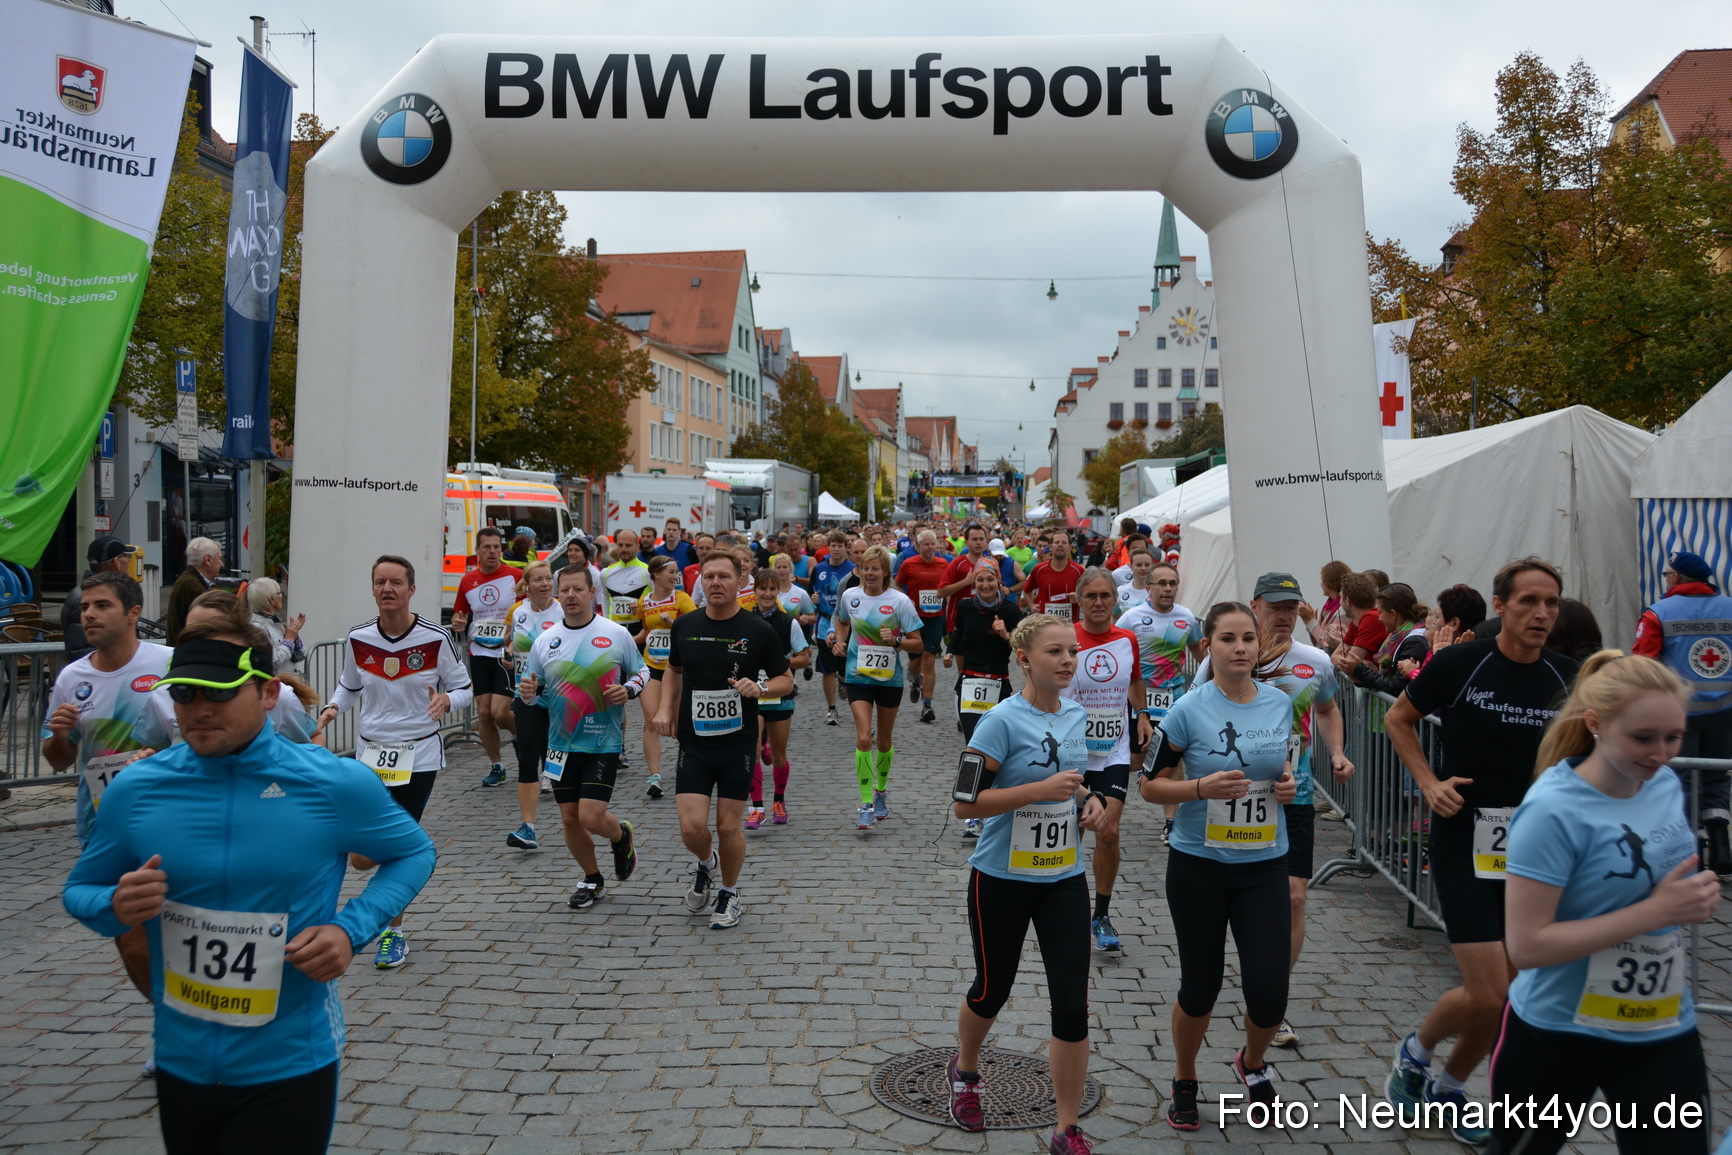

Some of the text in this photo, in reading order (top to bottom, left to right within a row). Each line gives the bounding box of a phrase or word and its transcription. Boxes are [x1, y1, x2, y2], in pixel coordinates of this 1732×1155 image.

[484, 52, 1174, 136] BMW Laufsport
[373, 95, 445, 125] BMW
[1213, 90, 1288, 120] BMW
[180, 360, 191, 386] P
[232, 414, 254, 428] rail
[103, 418, 112, 452] P
[134, 473, 140, 488] 3
[294, 476, 418, 492] www.bmw-laufsport.de
[1255, 469, 1383, 488] www.bmw-laufsport.de
[649, 500, 681, 508] Bayerisches
[477, 625, 504, 637] 2467
[866, 654, 889, 668] 273
[974, 687, 988, 700] 61
[1146, 693, 1170, 708] 164
[1465, 686, 1495, 705] Vegan
[697, 700, 738, 719] 2688
[1480, 699, 1523, 714] Laufen
[584, 716, 596, 724] 16.
[703, 721, 731, 730] Manfred
[1501, 713, 1543, 727] Leiden
[1085, 720, 1121, 738] 2055
[1246, 729, 1271, 739] GYM
[376, 750, 399, 768] 89
[1247, 787, 1268, 795] umarkt
[1016, 809, 1071, 819] PARTL Neumarkt
[1225, 797, 1267, 823] 115
[1030, 820, 1068, 849] 191
[1226, 829, 1262, 840] Antonia
[1491, 826, 1506, 852] 2
[1032, 855, 1063, 866] Sandra
[1493, 859, 1506, 869] An
[163, 911, 264, 936] PARTL Neumarkt
[182, 934, 257, 982] 134
[1611, 956, 1675, 996] 331
[180, 980, 252, 1014] Wolfgang
[1616, 1003, 1658, 1019] Katrin
